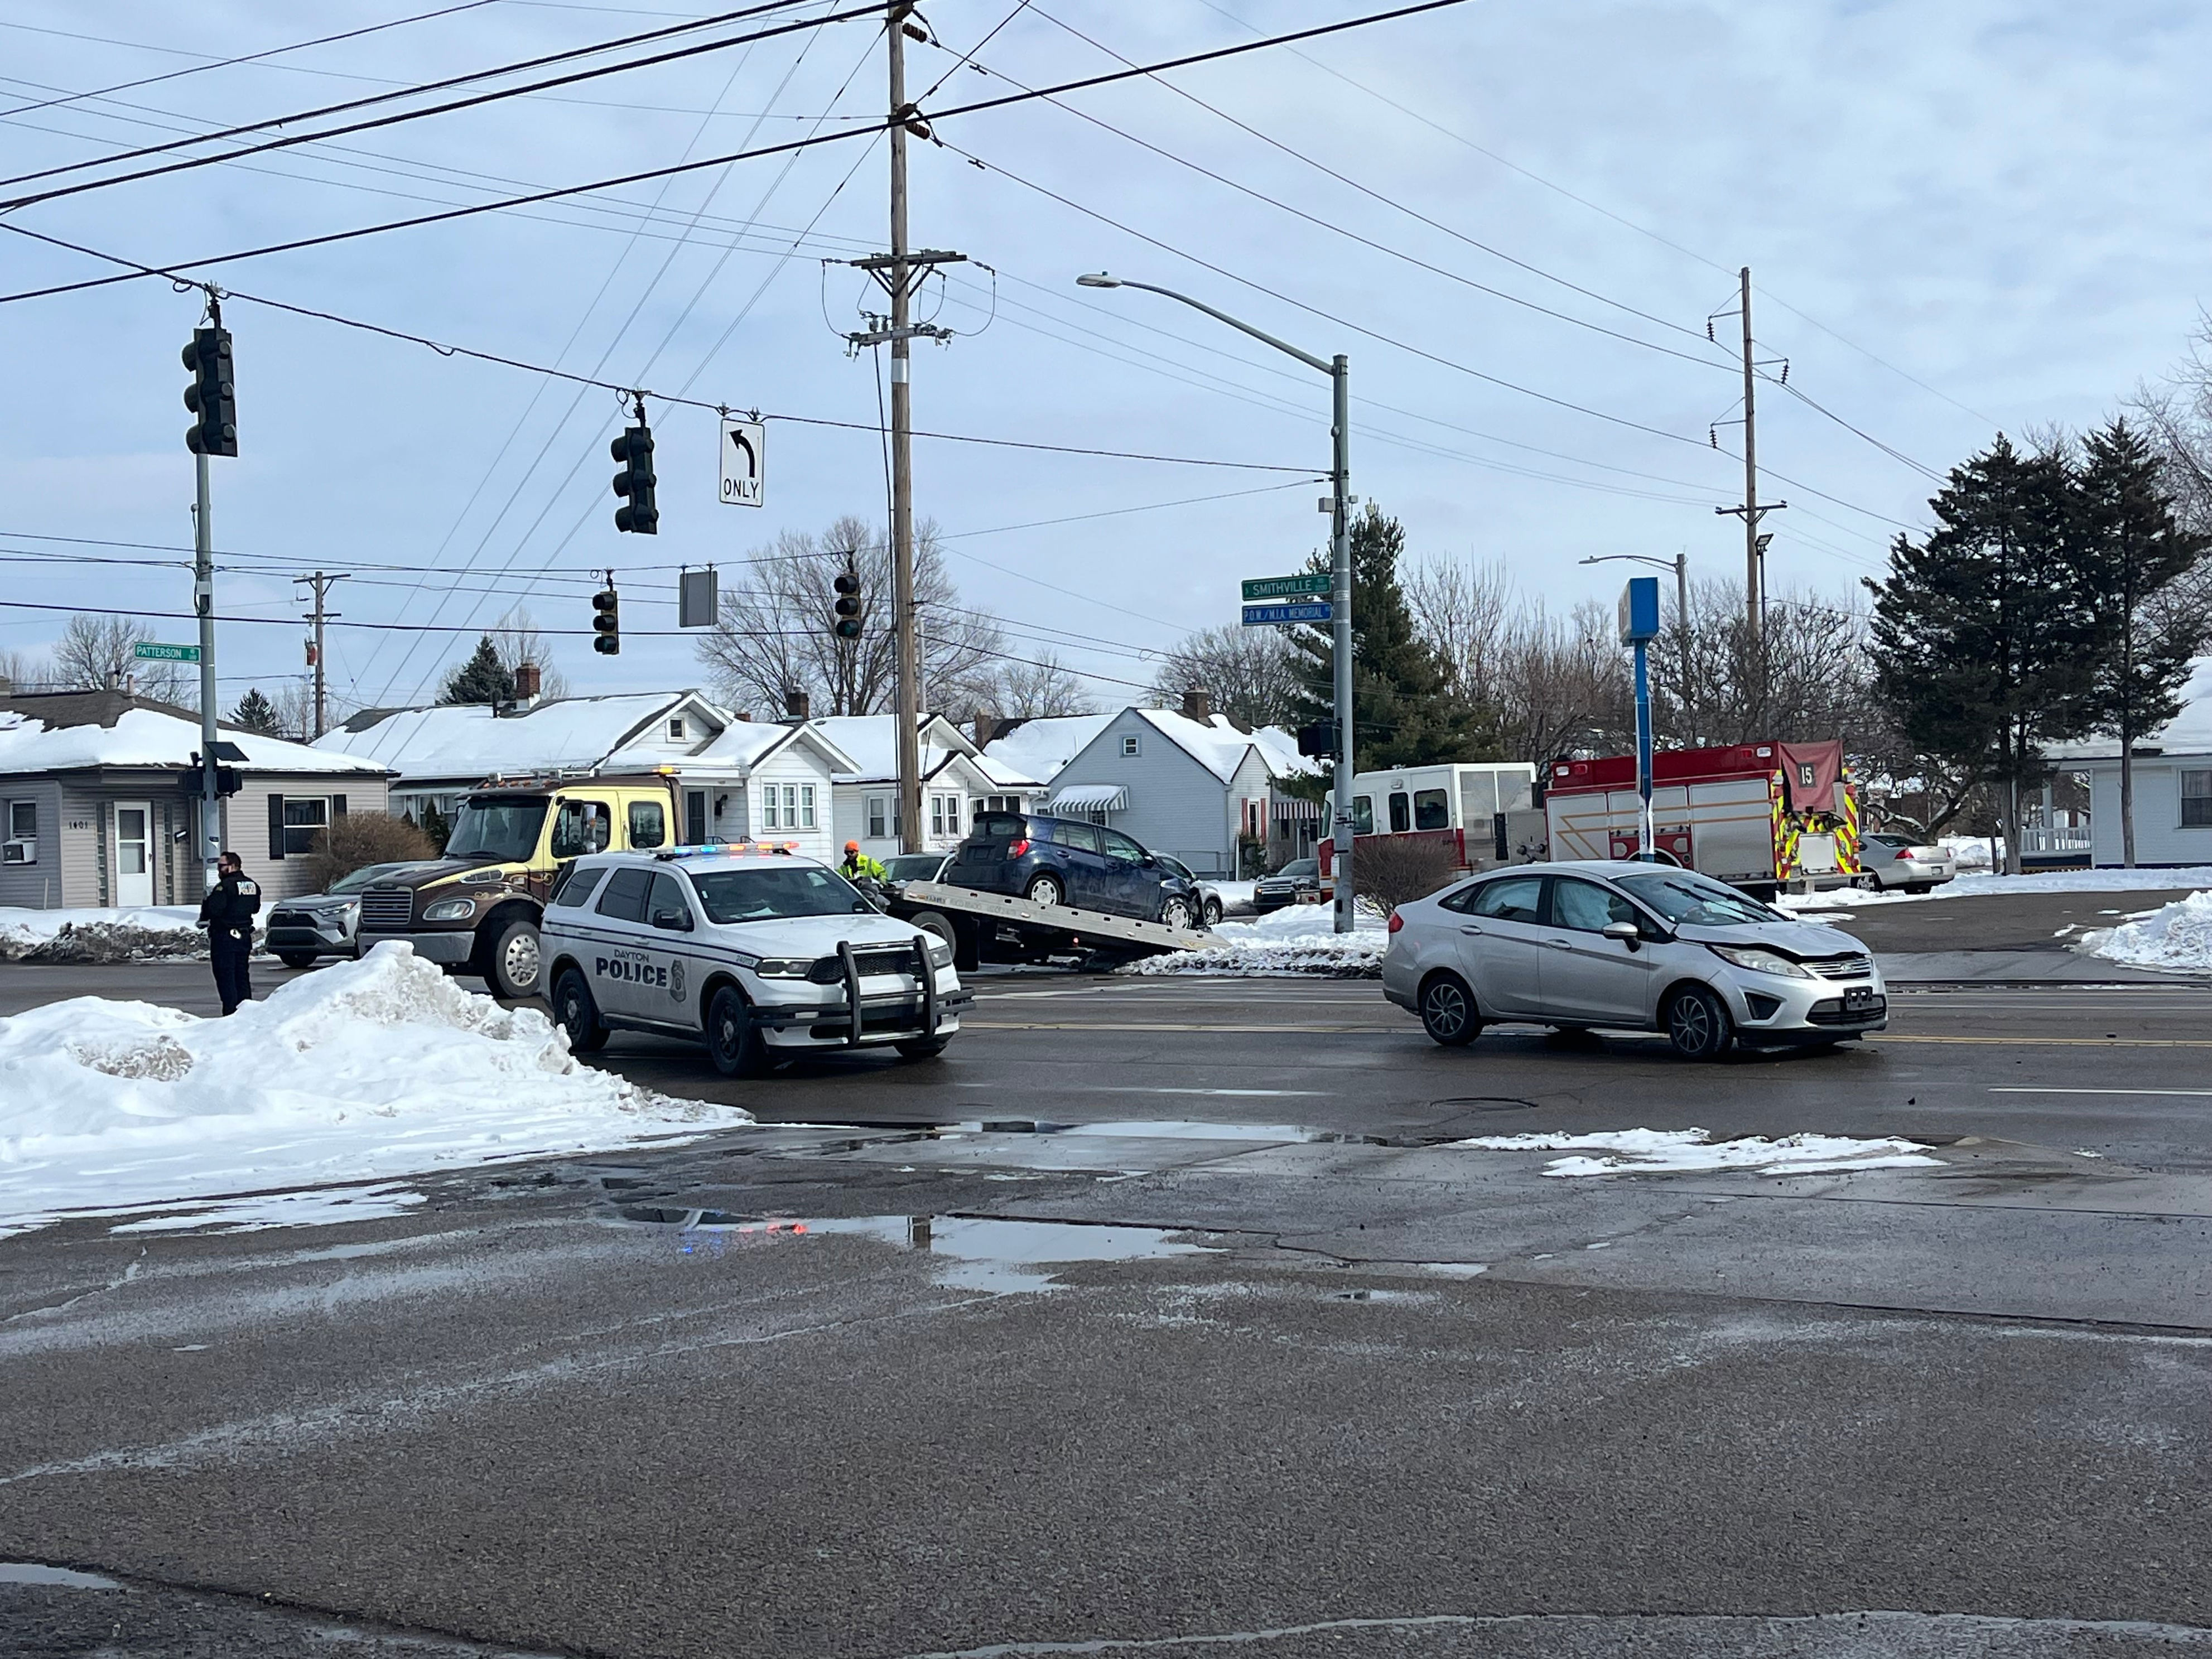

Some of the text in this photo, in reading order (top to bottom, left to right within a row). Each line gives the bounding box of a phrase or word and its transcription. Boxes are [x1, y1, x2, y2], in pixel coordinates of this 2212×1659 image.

[724, 478, 759, 499] ONLY
[1253, 580, 1312, 596] SMITHVILLE
[1289, 606, 1323, 619] MEMORIAL
[136, 646, 182, 659] PATTERSON
[1801, 766, 1813, 784] 15
[614, 949, 649, 963] DAYTON
[596, 957, 667, 987] POLICE
